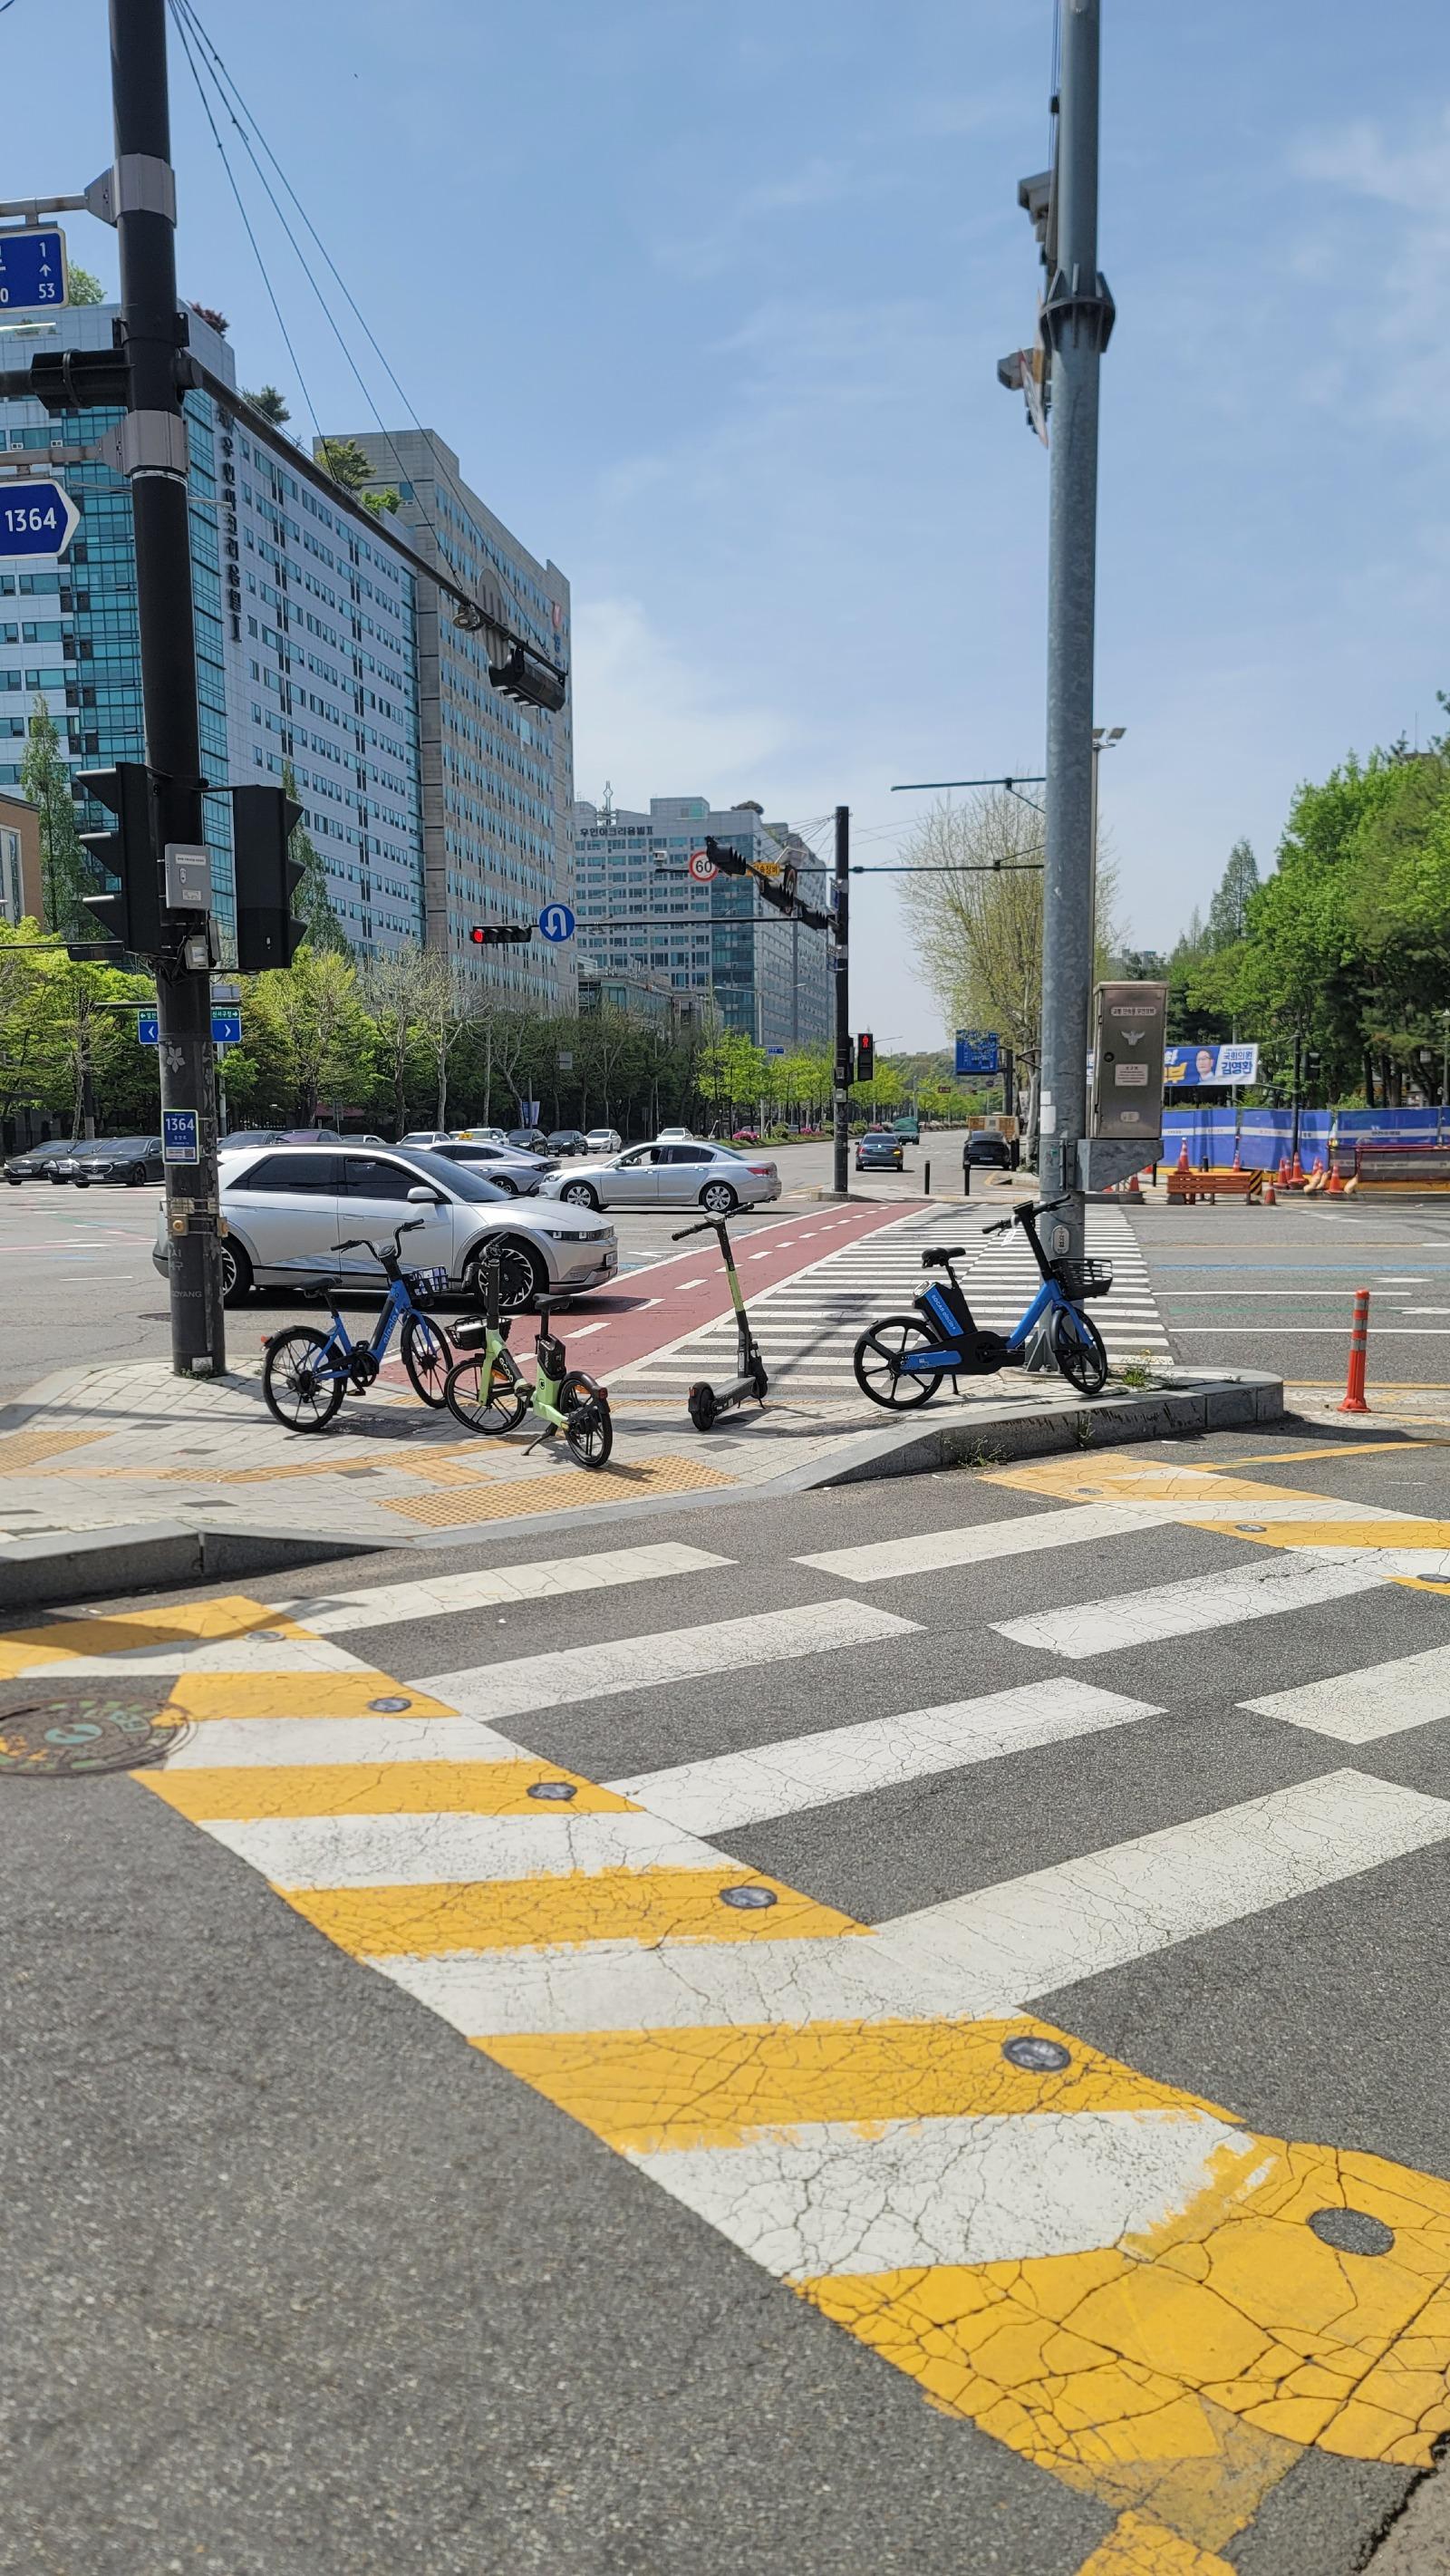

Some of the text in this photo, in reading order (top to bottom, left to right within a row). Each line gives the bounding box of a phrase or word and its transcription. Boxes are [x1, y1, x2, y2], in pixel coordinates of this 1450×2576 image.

[39, 241, 46, 257] 1
[38, 283, 55, 299] 53
[5, 508, 57, 532] 1364
[695, 860, 712, 873] 60
[1223, 1051, 1252, 1060] 국회의원
[1222, 1061, 1252, 1075] 김영환
[166, 1118, 195, 1131] 1364
